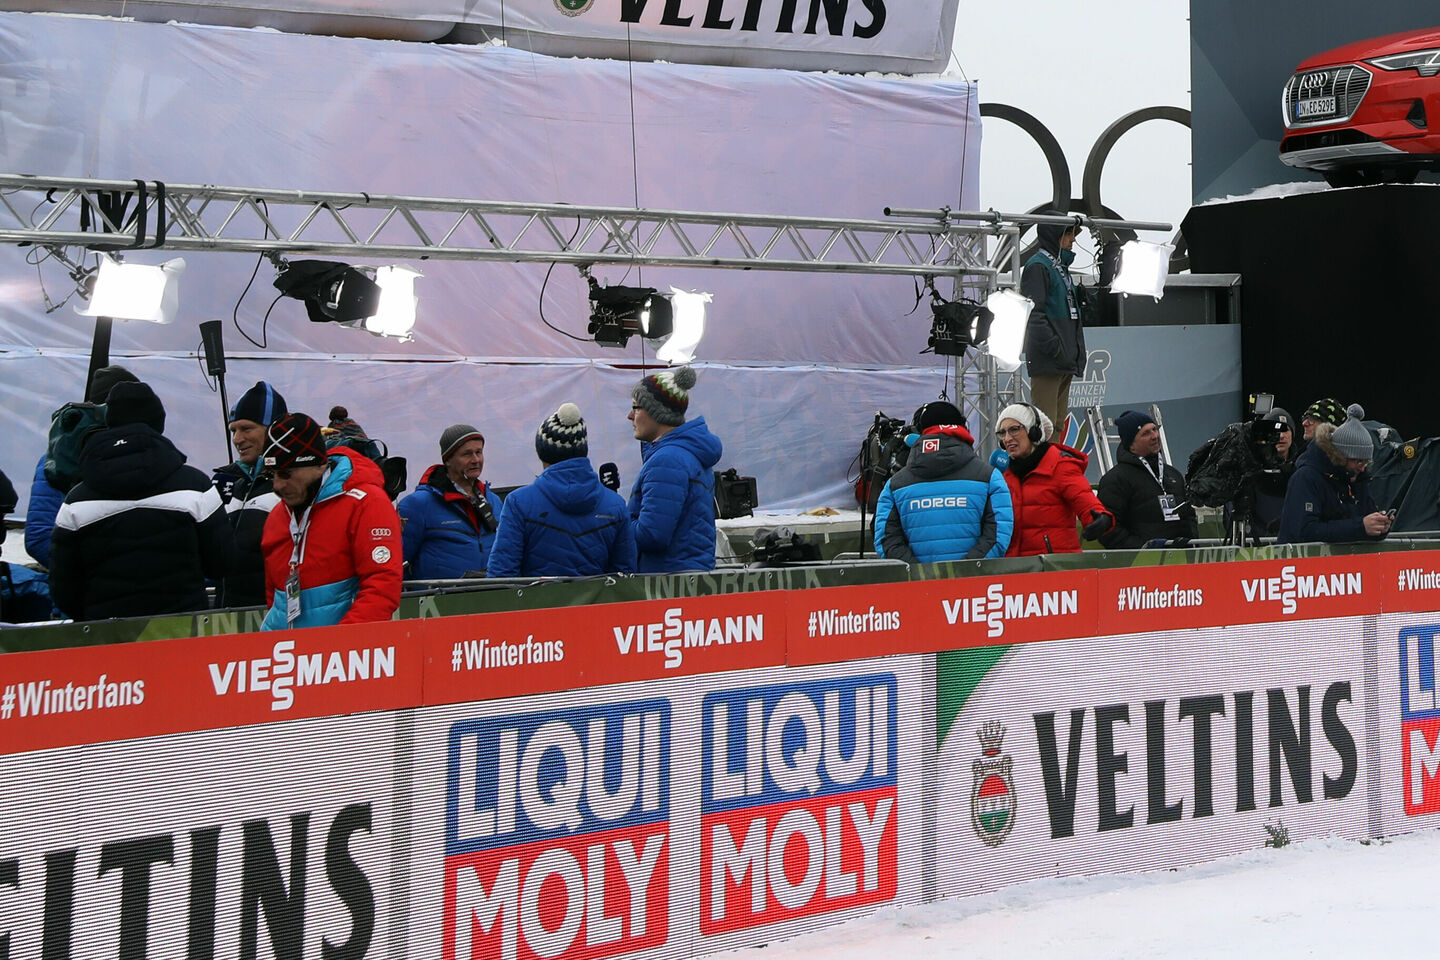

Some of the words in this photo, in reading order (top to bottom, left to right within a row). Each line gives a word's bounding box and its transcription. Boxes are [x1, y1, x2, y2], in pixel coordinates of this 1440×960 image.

[1067, 396, 1104, 408] OURNEE
[1069, 384, 1106, 396] HANZEN
[910, 496, 967, 510] NORGE
[1117, 583, 1203, 612] #Winterfans
[808, 605, 900, 638] #Winterfans
[452, 634, 564, 672] #Winterfans
[1, 674, 145, 719] #Winterfans
[712, 683, 888, 801] LIQUI
[1033, 681, 1358, 840] VELTINS
[456, 709, 662, 842] LIQUI
[0, 801, 376, 960] LTINS
[710, 797, 894, 921] MOLY
[453, 831, 668, 960] MOLY
